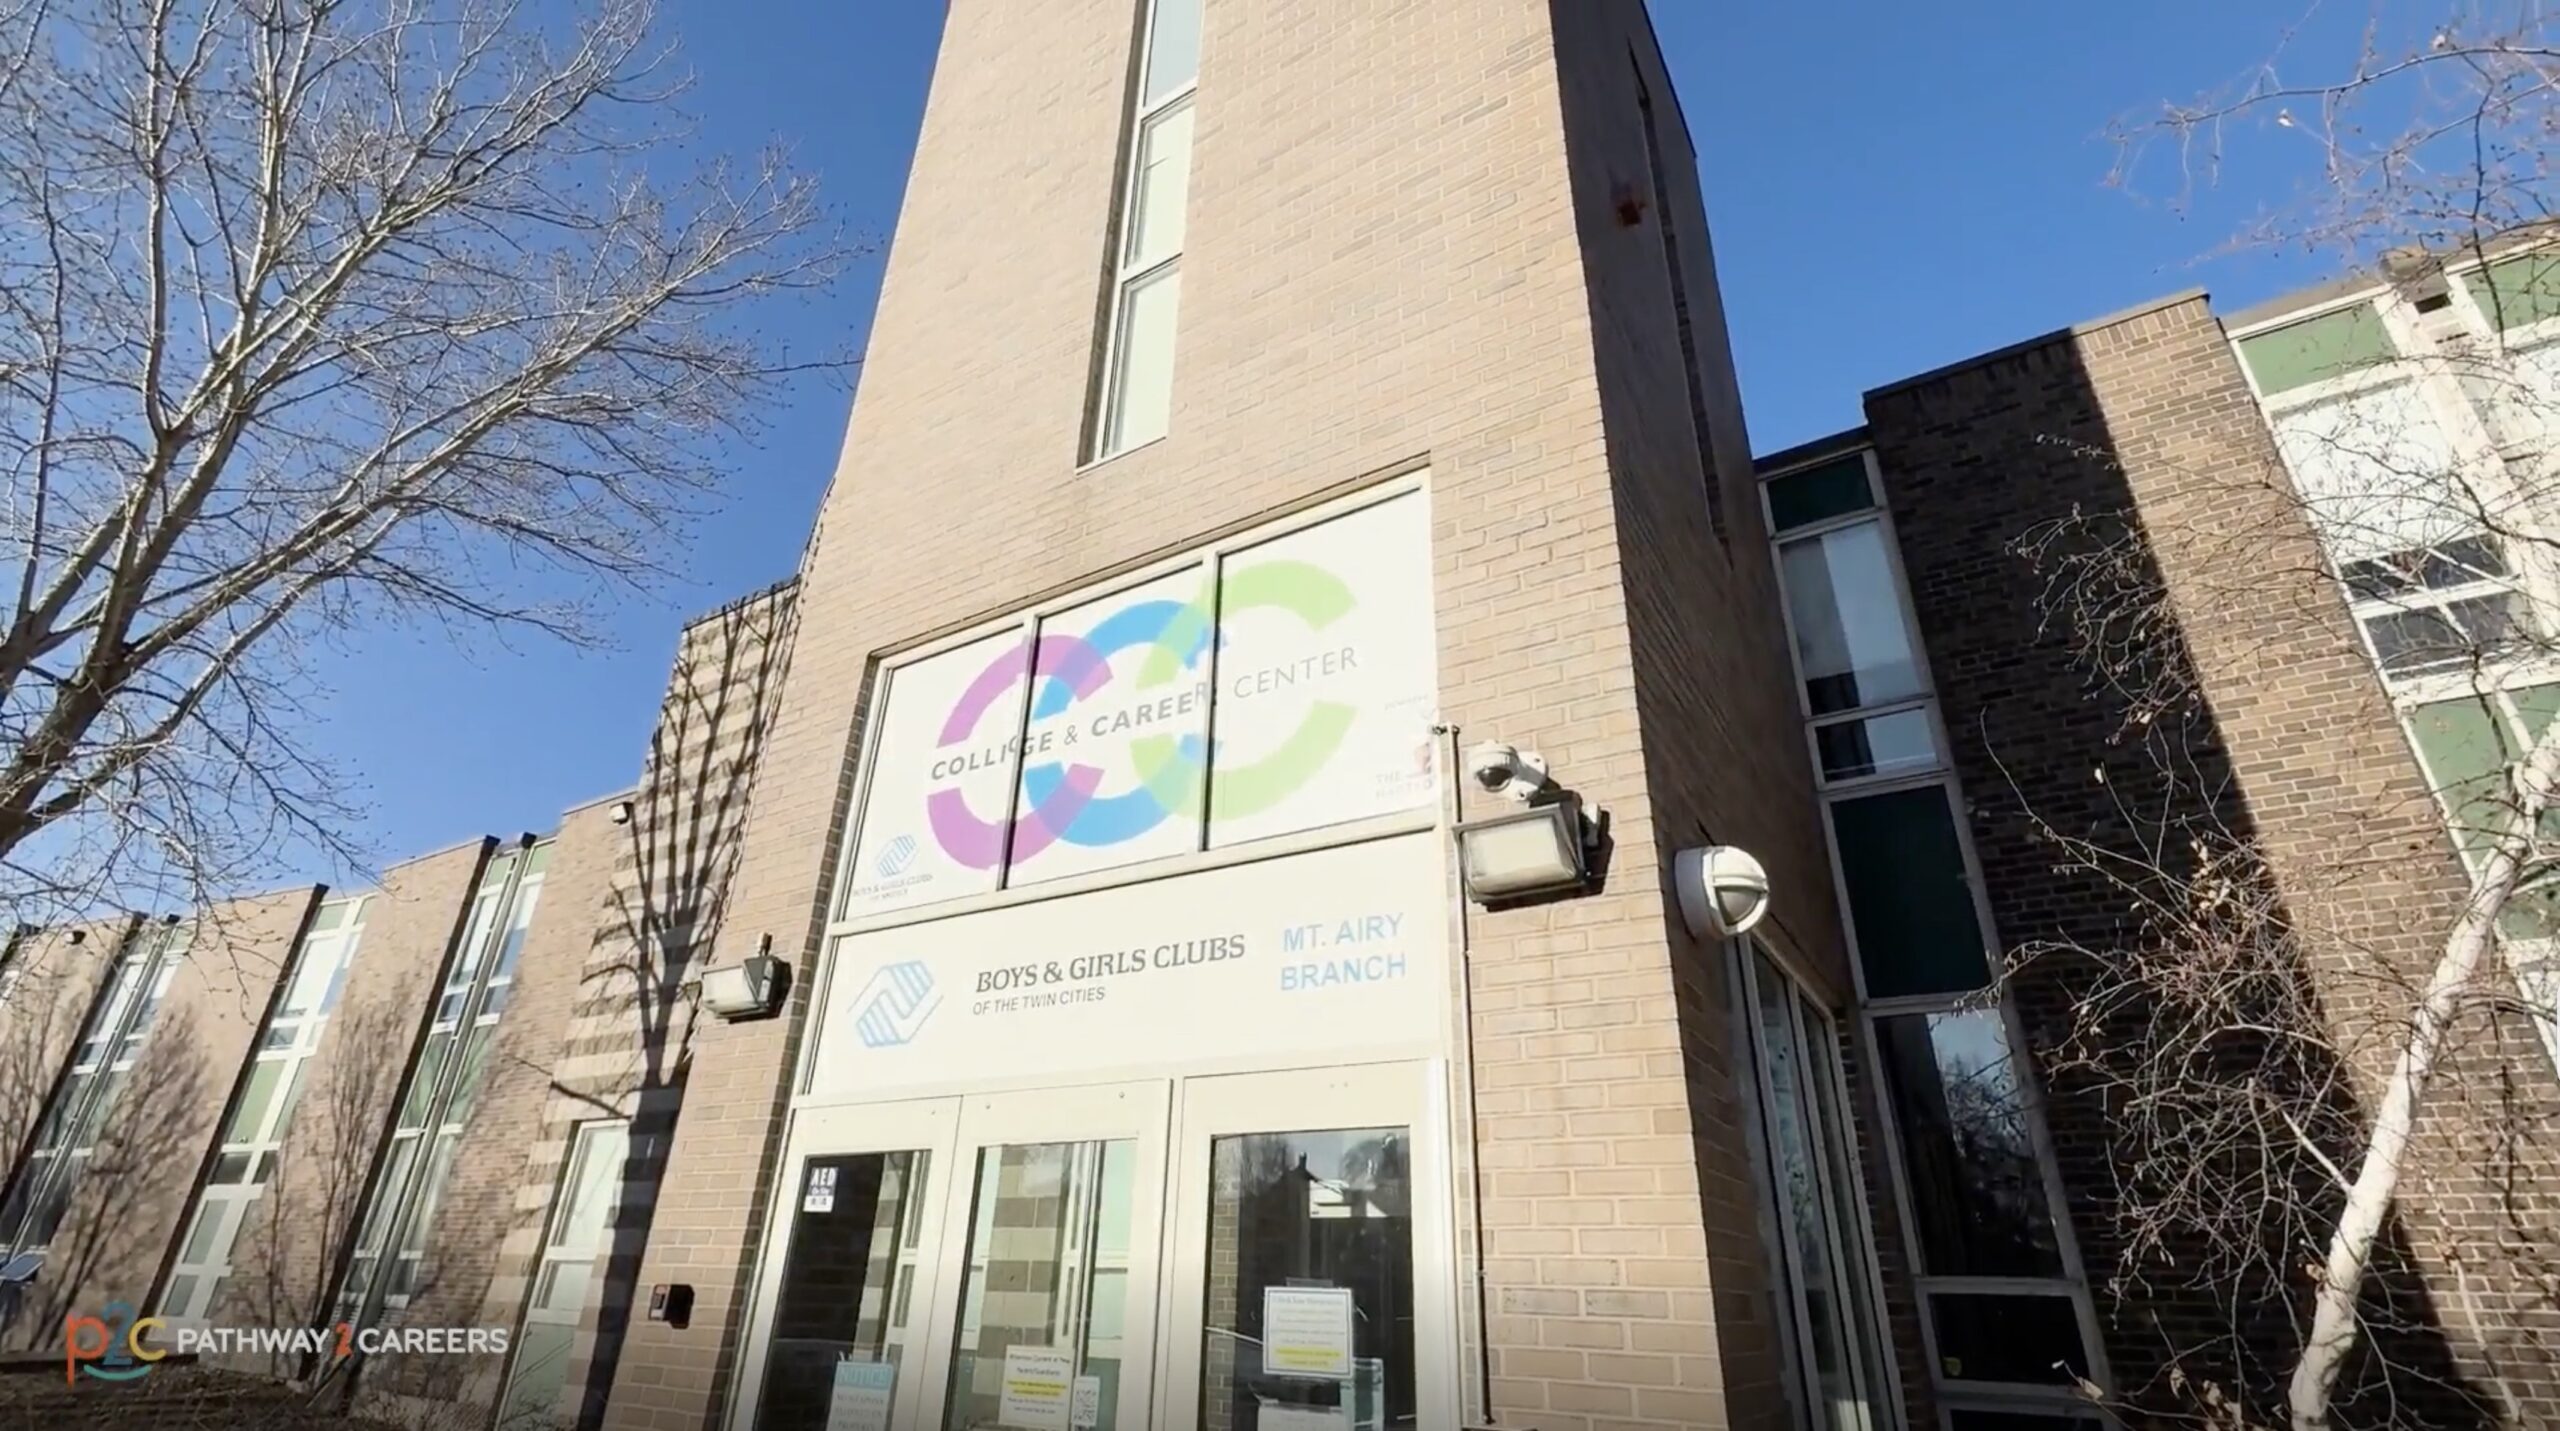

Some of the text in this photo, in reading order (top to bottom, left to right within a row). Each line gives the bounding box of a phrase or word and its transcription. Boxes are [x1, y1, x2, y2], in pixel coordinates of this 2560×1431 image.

[1063, 724, 1078, 745] &
[1091, 681, 1209, 737] CAREER
[1233, 647, 1358, 699] CENTER
[1283, 911, 1404, 952] MT. AIRY
[975, 934, 1246, 992] BOYS & GIRLS CLUBS
[1280, 952, 1406, 991] BRANCH
[972, 986, 1106, 1016] OF THE TWIN CITIES
[811, 1167, 836, 1186] AED
